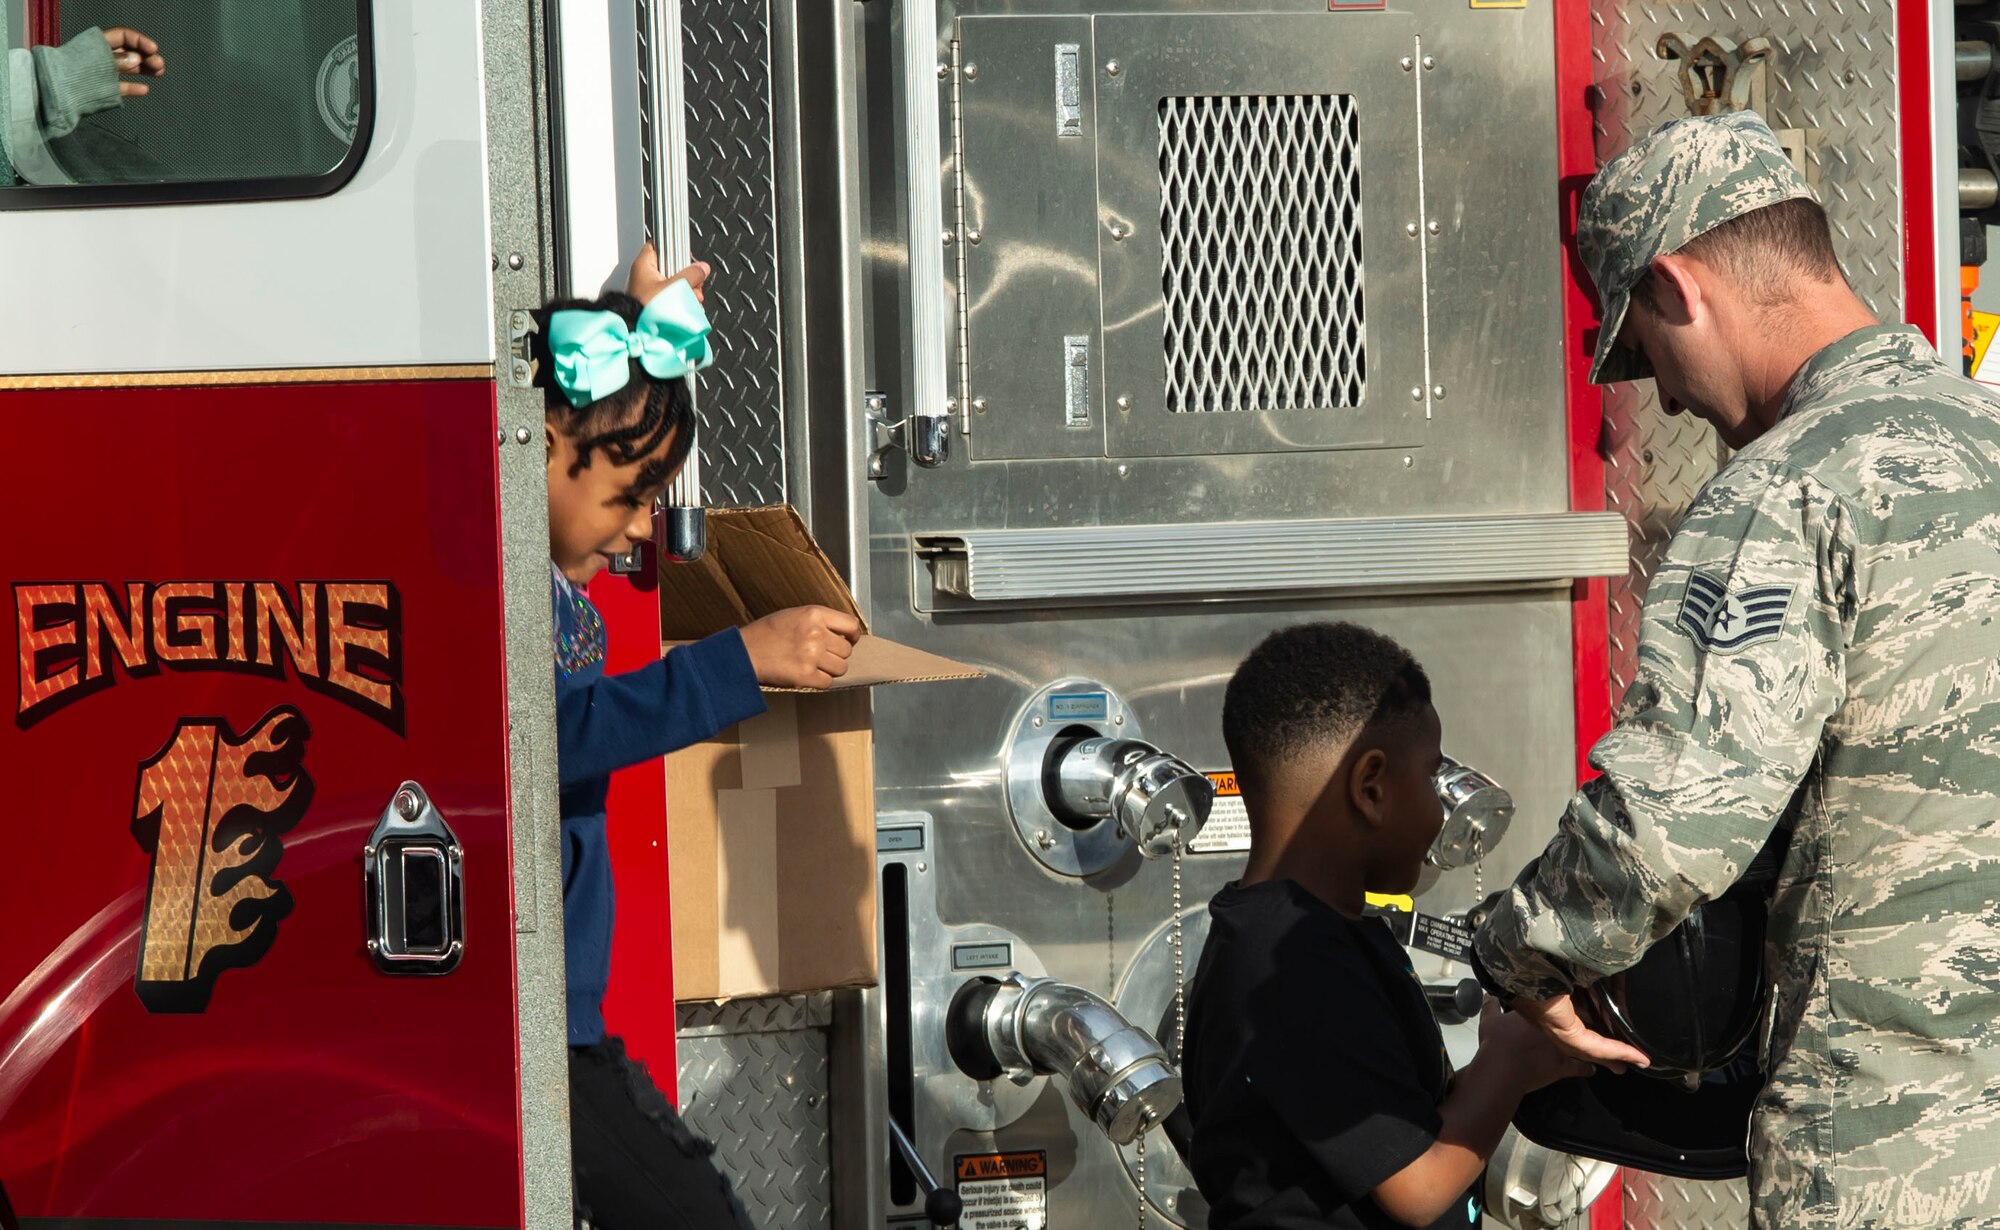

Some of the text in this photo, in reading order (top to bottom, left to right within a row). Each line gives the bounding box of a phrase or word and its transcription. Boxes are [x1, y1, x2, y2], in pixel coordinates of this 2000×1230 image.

[12, 580, 403, 728] ENGINE
[133, 708, 300, 992] 1
[1418, 925, 1428, 933] MAX
[1430, 929, 1455, 942] OPERATING
[1451, 927, 1469, 938] MANUAL
[981, 1158, 1038, 1174] WARNING
[961, 1186, 982, 1195] Serious
[1008, 1183, 1024, 1191] death
[1026, 1181, 1042, 1190] could
[969, 1210, 1002, 1219] pressurized
[1003, 1208, 1022, 1216] source
[986, 1221, 1001, 1229] valve
